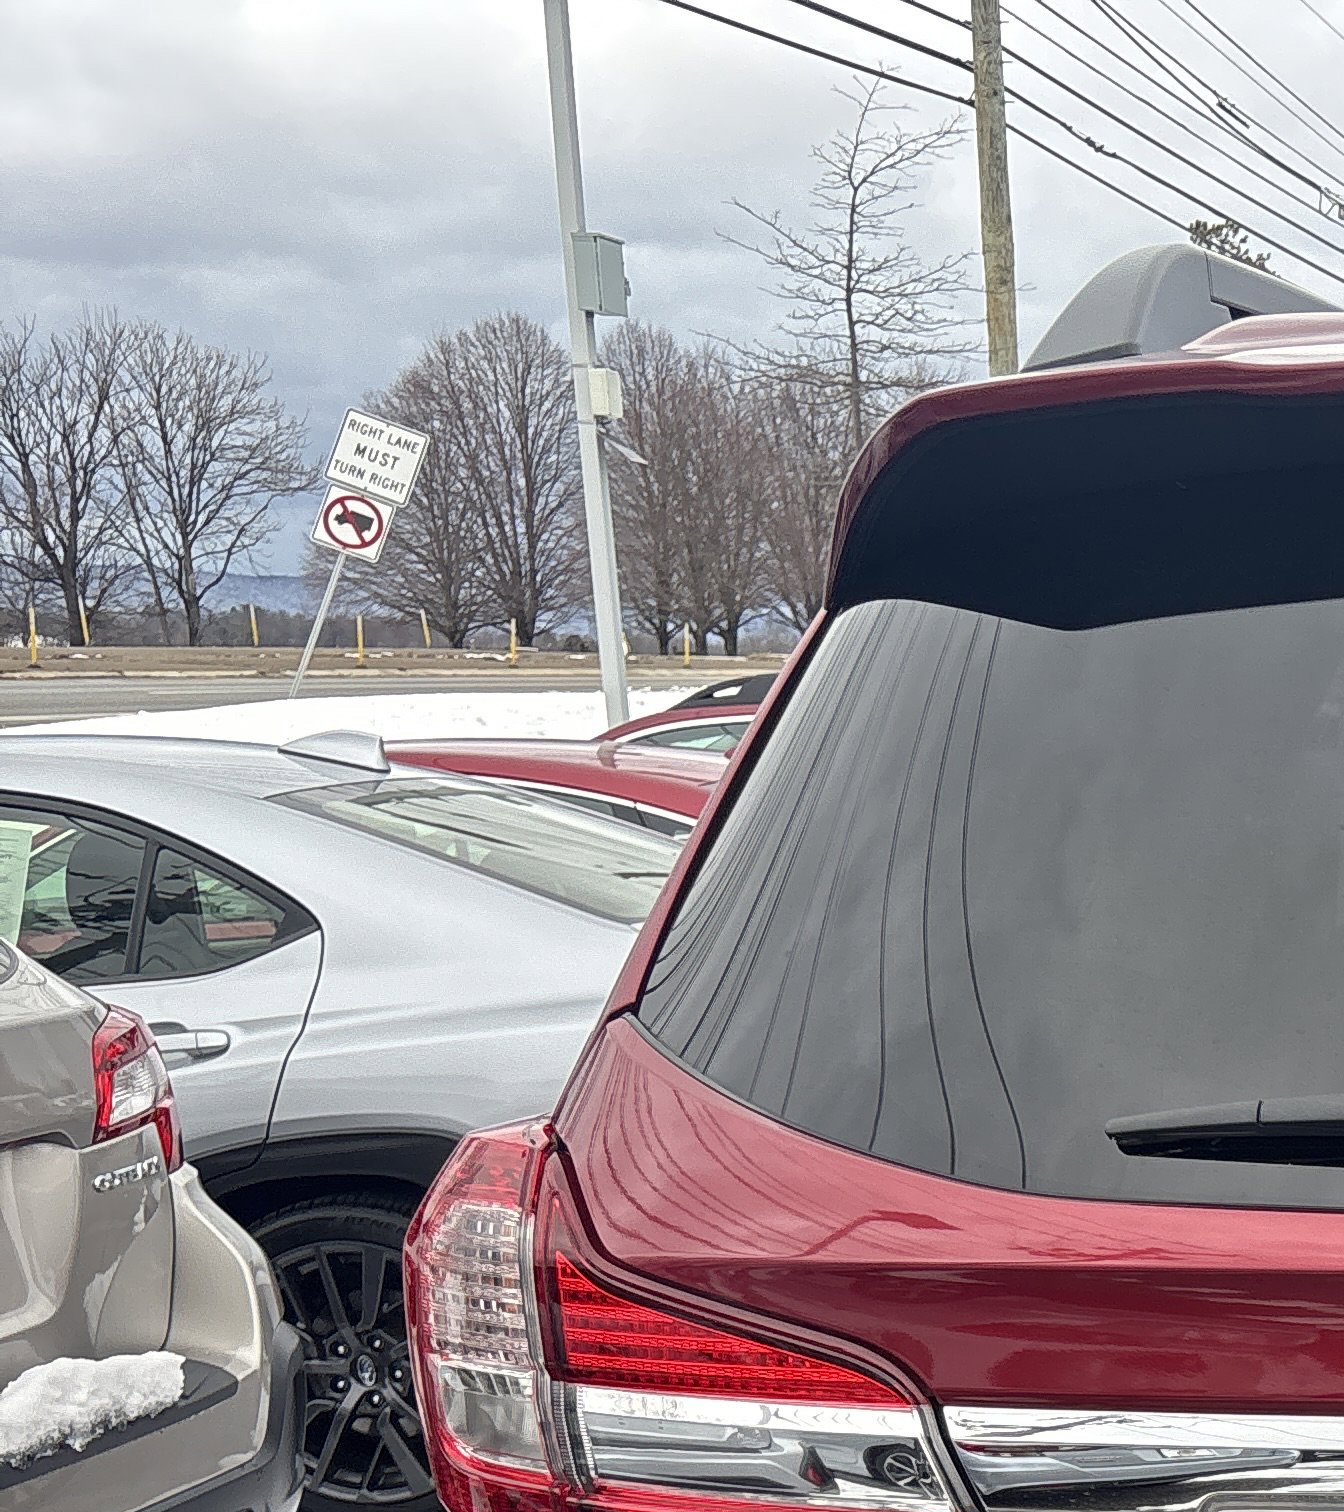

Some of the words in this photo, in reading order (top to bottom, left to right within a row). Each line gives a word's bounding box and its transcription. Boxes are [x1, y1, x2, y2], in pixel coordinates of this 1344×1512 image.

[348, 418, 385, 441] RIGHT
[387, 433, 420, 455] LANE
[353, 442, 400, 470] MUST
[333, 459, 366, 480] TURN
[369, 472, 406, 494] RIGHT
